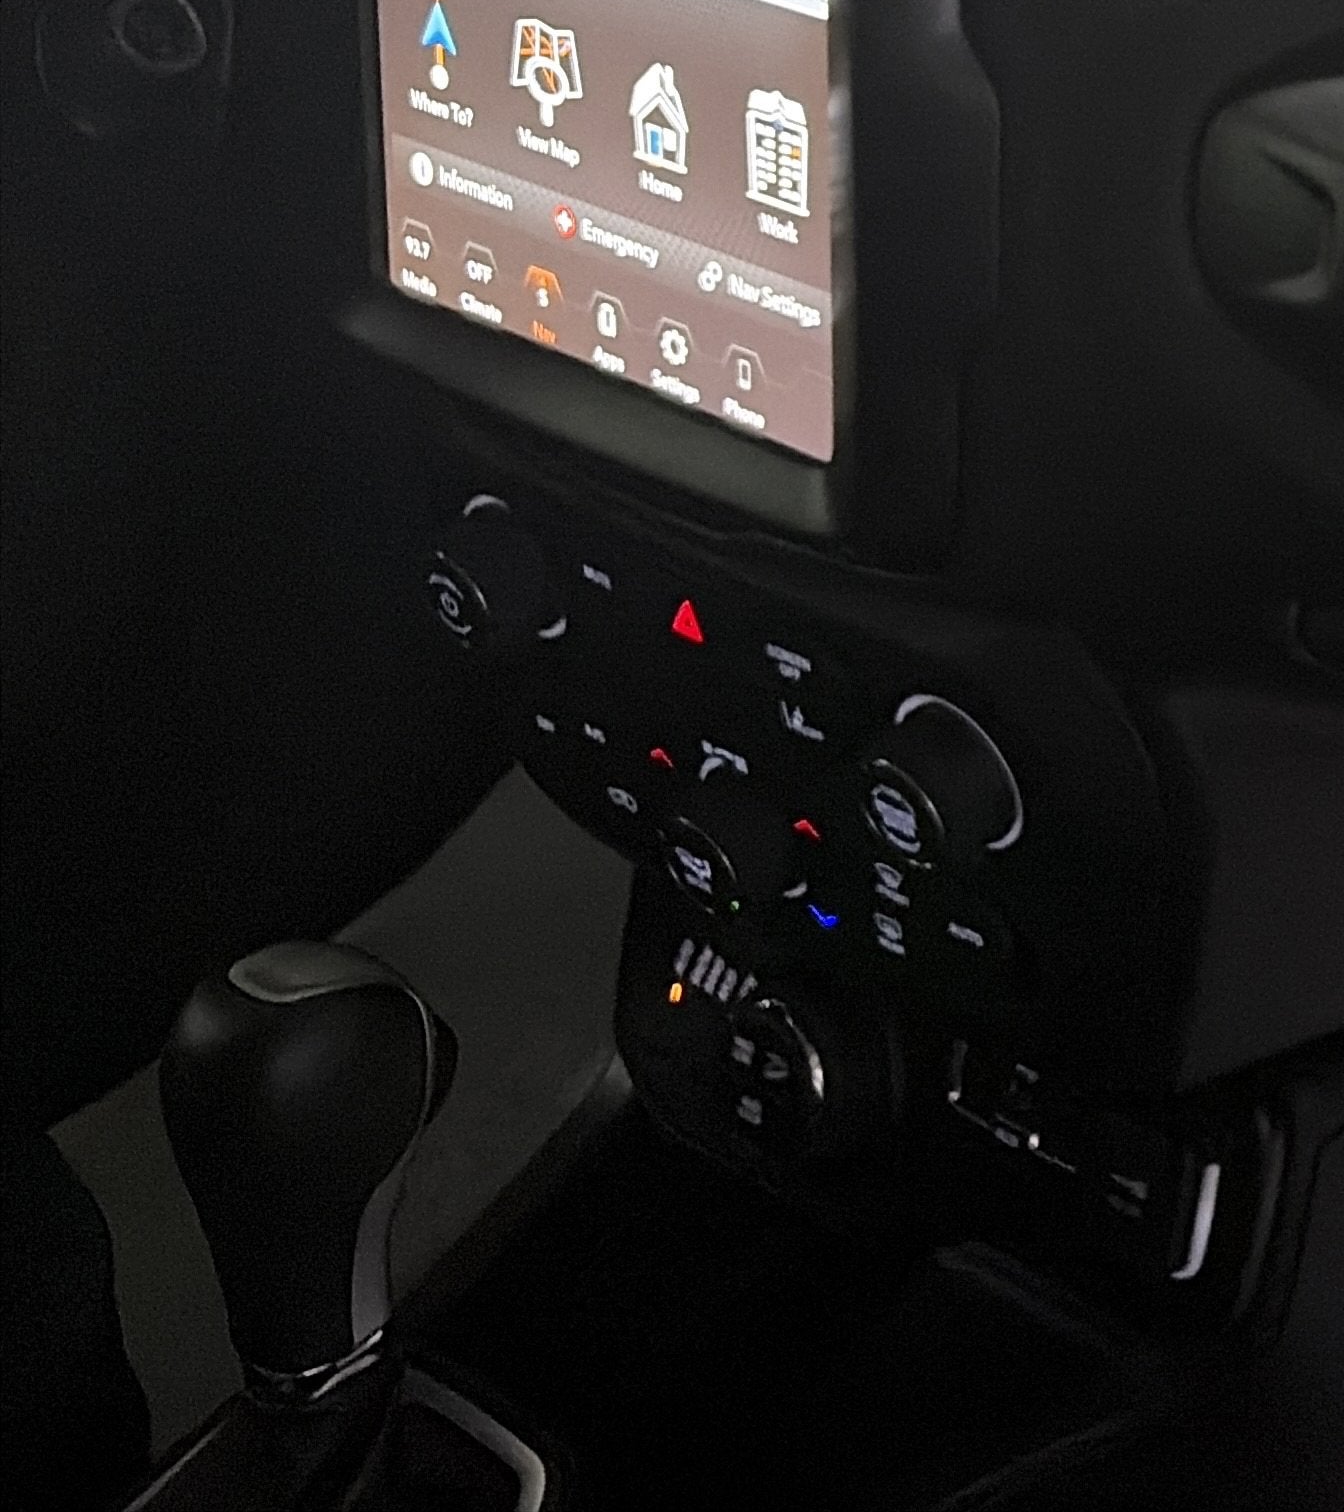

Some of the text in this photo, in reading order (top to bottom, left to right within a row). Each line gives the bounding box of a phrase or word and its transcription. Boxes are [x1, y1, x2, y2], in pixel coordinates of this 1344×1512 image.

[409, 87, 474, 128] Where To?
[516, 125, 581, 169] View Map
[439, 165, 514, 212] Information
[638, 170, 683, 202] Home
[580, 217, 660, 269] Emergency
[757, 212, 799, 245] Work
[401, 268, 438, 298] Media
[460, 291, 503, 324] Climate
[727, 273, 821, 328] Nav Settings
[533, 320, 556, 345] Nav
[592, 345, 626, 374] Apps
[651, 368, 701, 405] Settings
[722, 396, 766, 430] Phone
